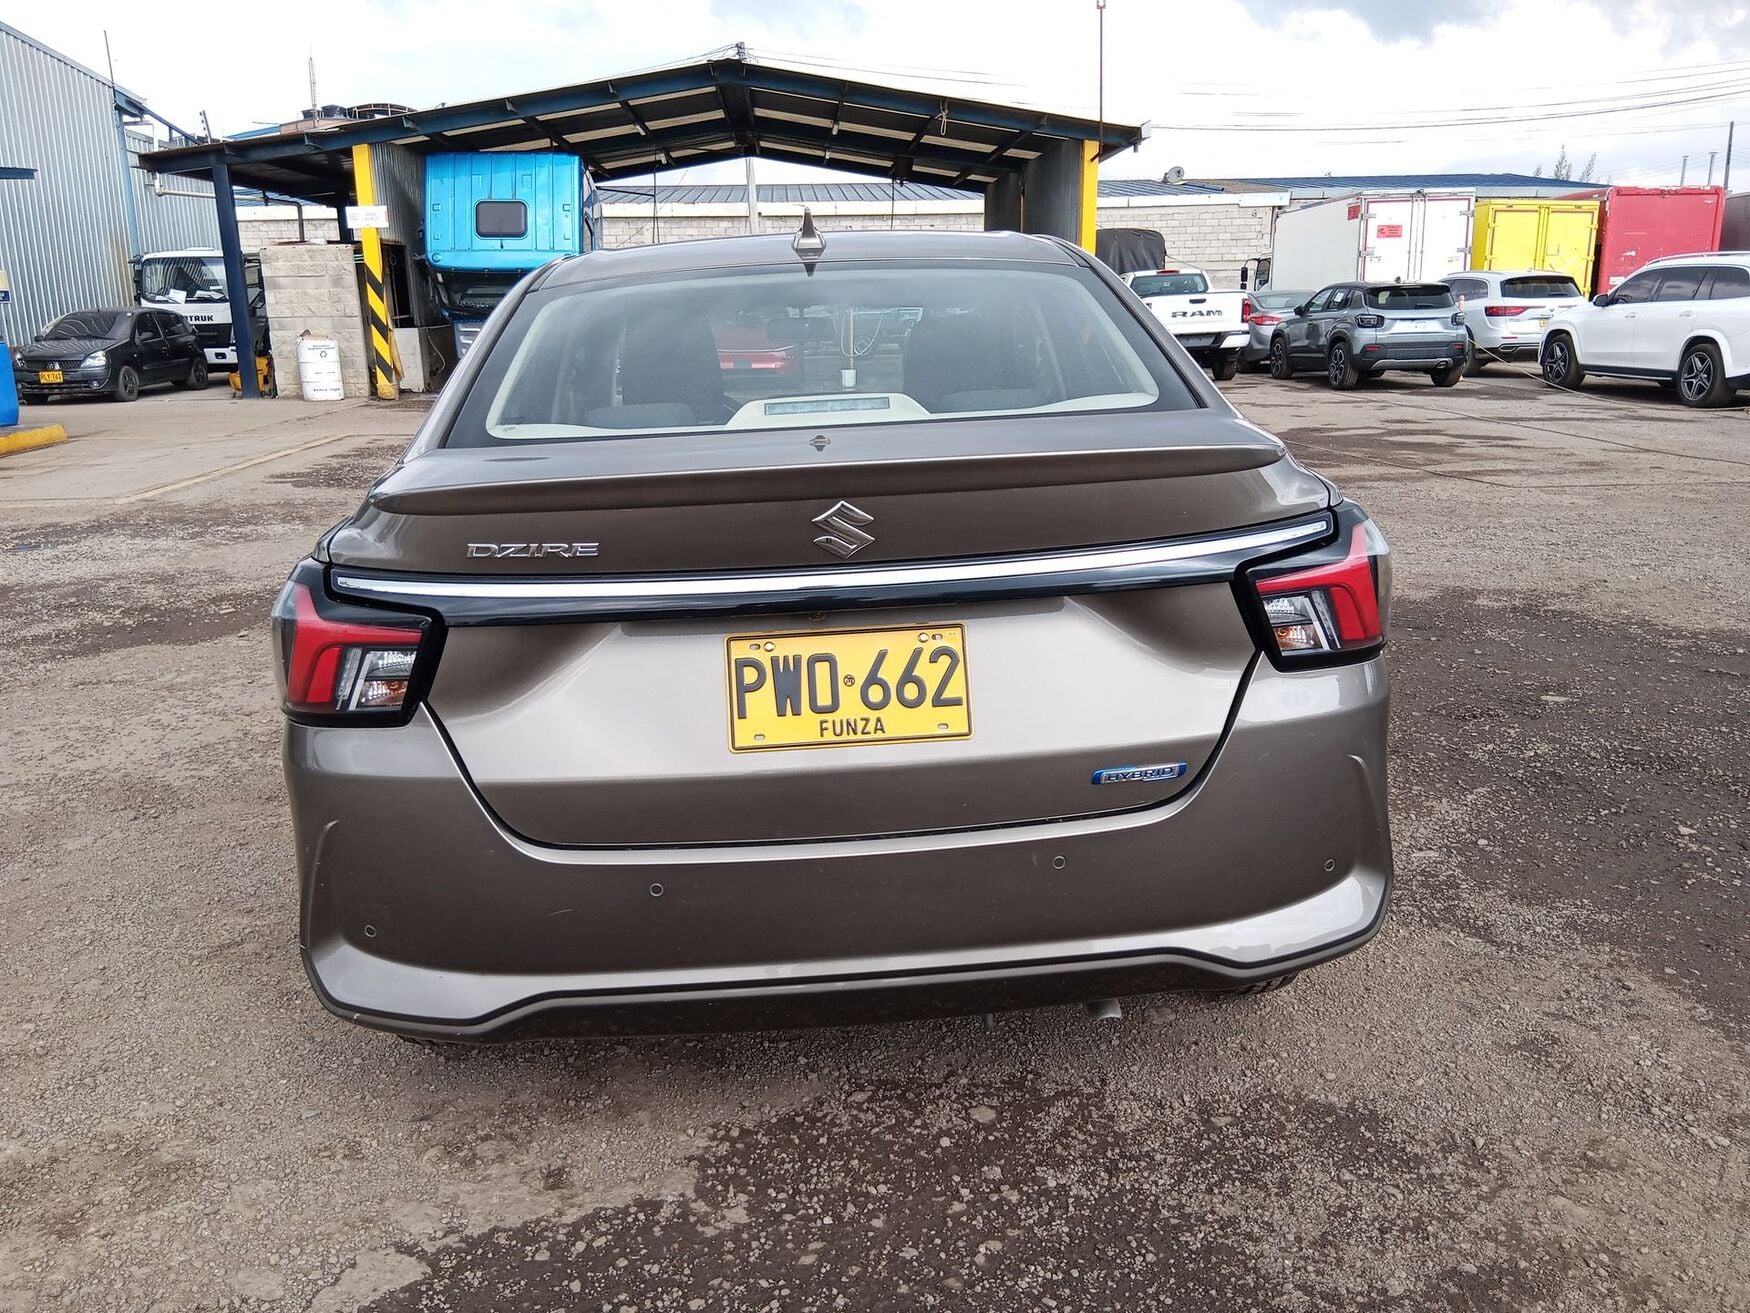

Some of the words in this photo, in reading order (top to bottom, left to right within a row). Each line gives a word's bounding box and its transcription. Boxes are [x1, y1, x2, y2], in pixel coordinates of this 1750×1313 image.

[1171, 310, 1223, 318] RAM
[466, 542, 600, 558] DZIRE
[819, 716, 886, 738] FUNZA
[1106, 767, 1174, 782] HYBRID
